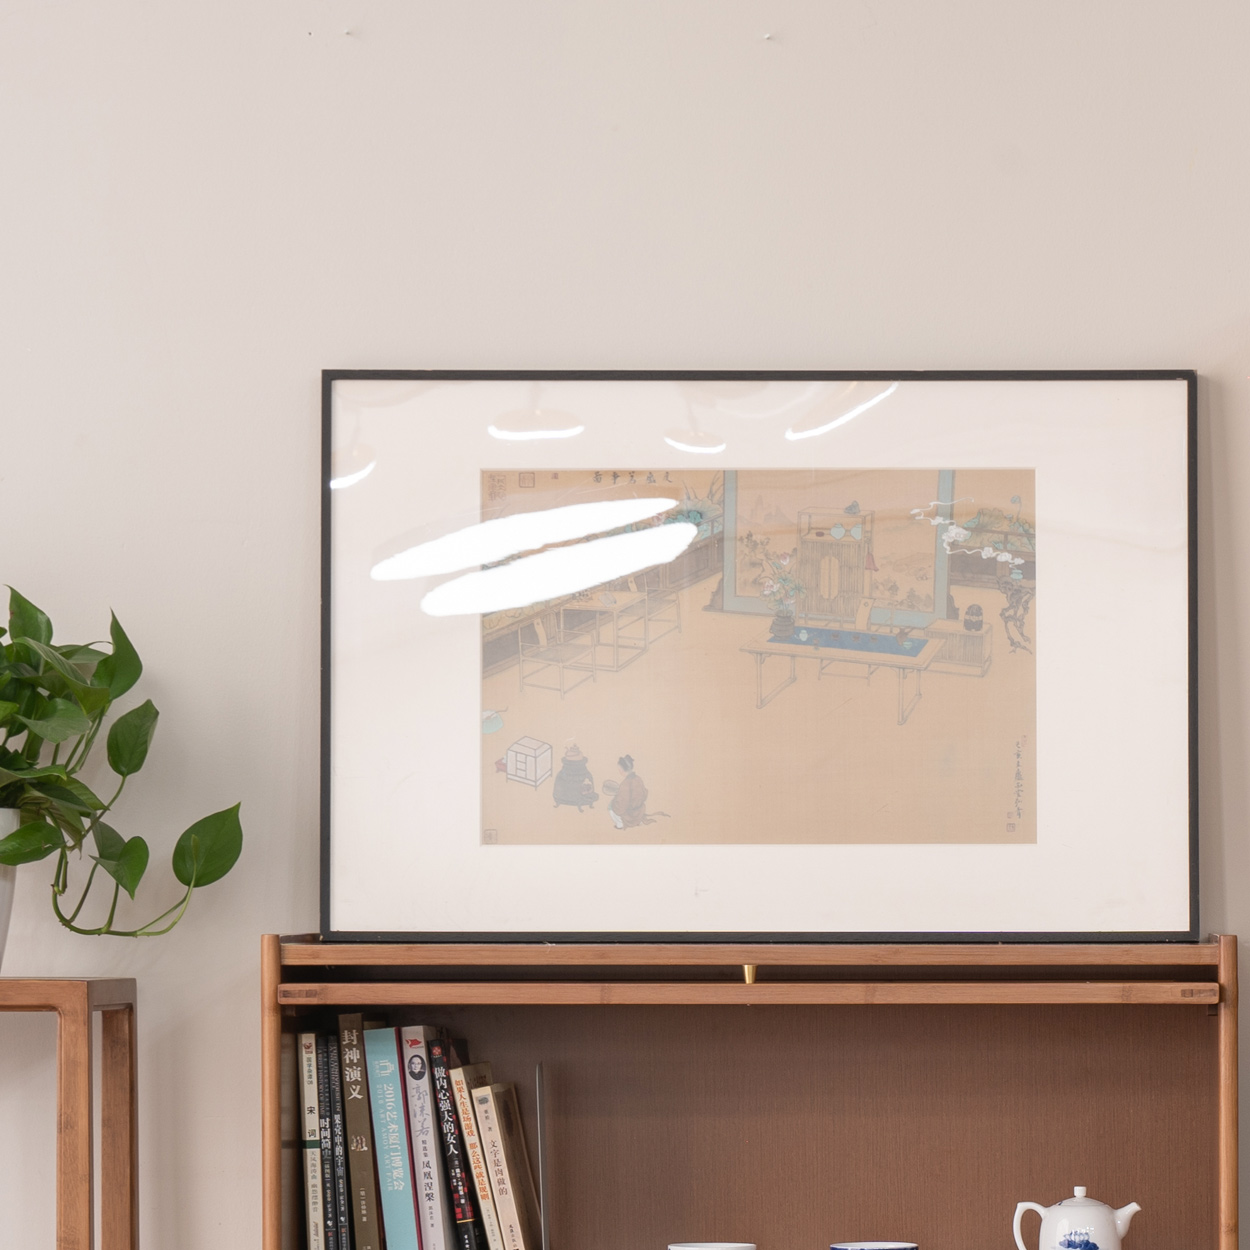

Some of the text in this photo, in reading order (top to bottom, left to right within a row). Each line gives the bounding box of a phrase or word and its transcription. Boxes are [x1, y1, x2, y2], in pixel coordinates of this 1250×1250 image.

[342, 1029, 364, 1100] 封神演义
[320, 1117, 332, 1160] 时间简史
[376, 1084, 384, 1104] 2016
[381, 1128, 389, 1150] AMOY
[383, 1083, 405, 1191] 2016艺术厦门博览会
[411, 1083, 430, 1137] 郭沫若
[434, 1066, 459, 1156] 做内心强大的女人
[454, 1079, 475, 1137] 如果人生是场游戏
[469, 1142, 490, 1201] 那么这些就是规则
[334, 1114, 345, 1177] 果壳中的宇宙
[490, 1139, 508, 1196] 文字是肉做的
[422, 1160, 435, 1202] 凤凰涅槃
